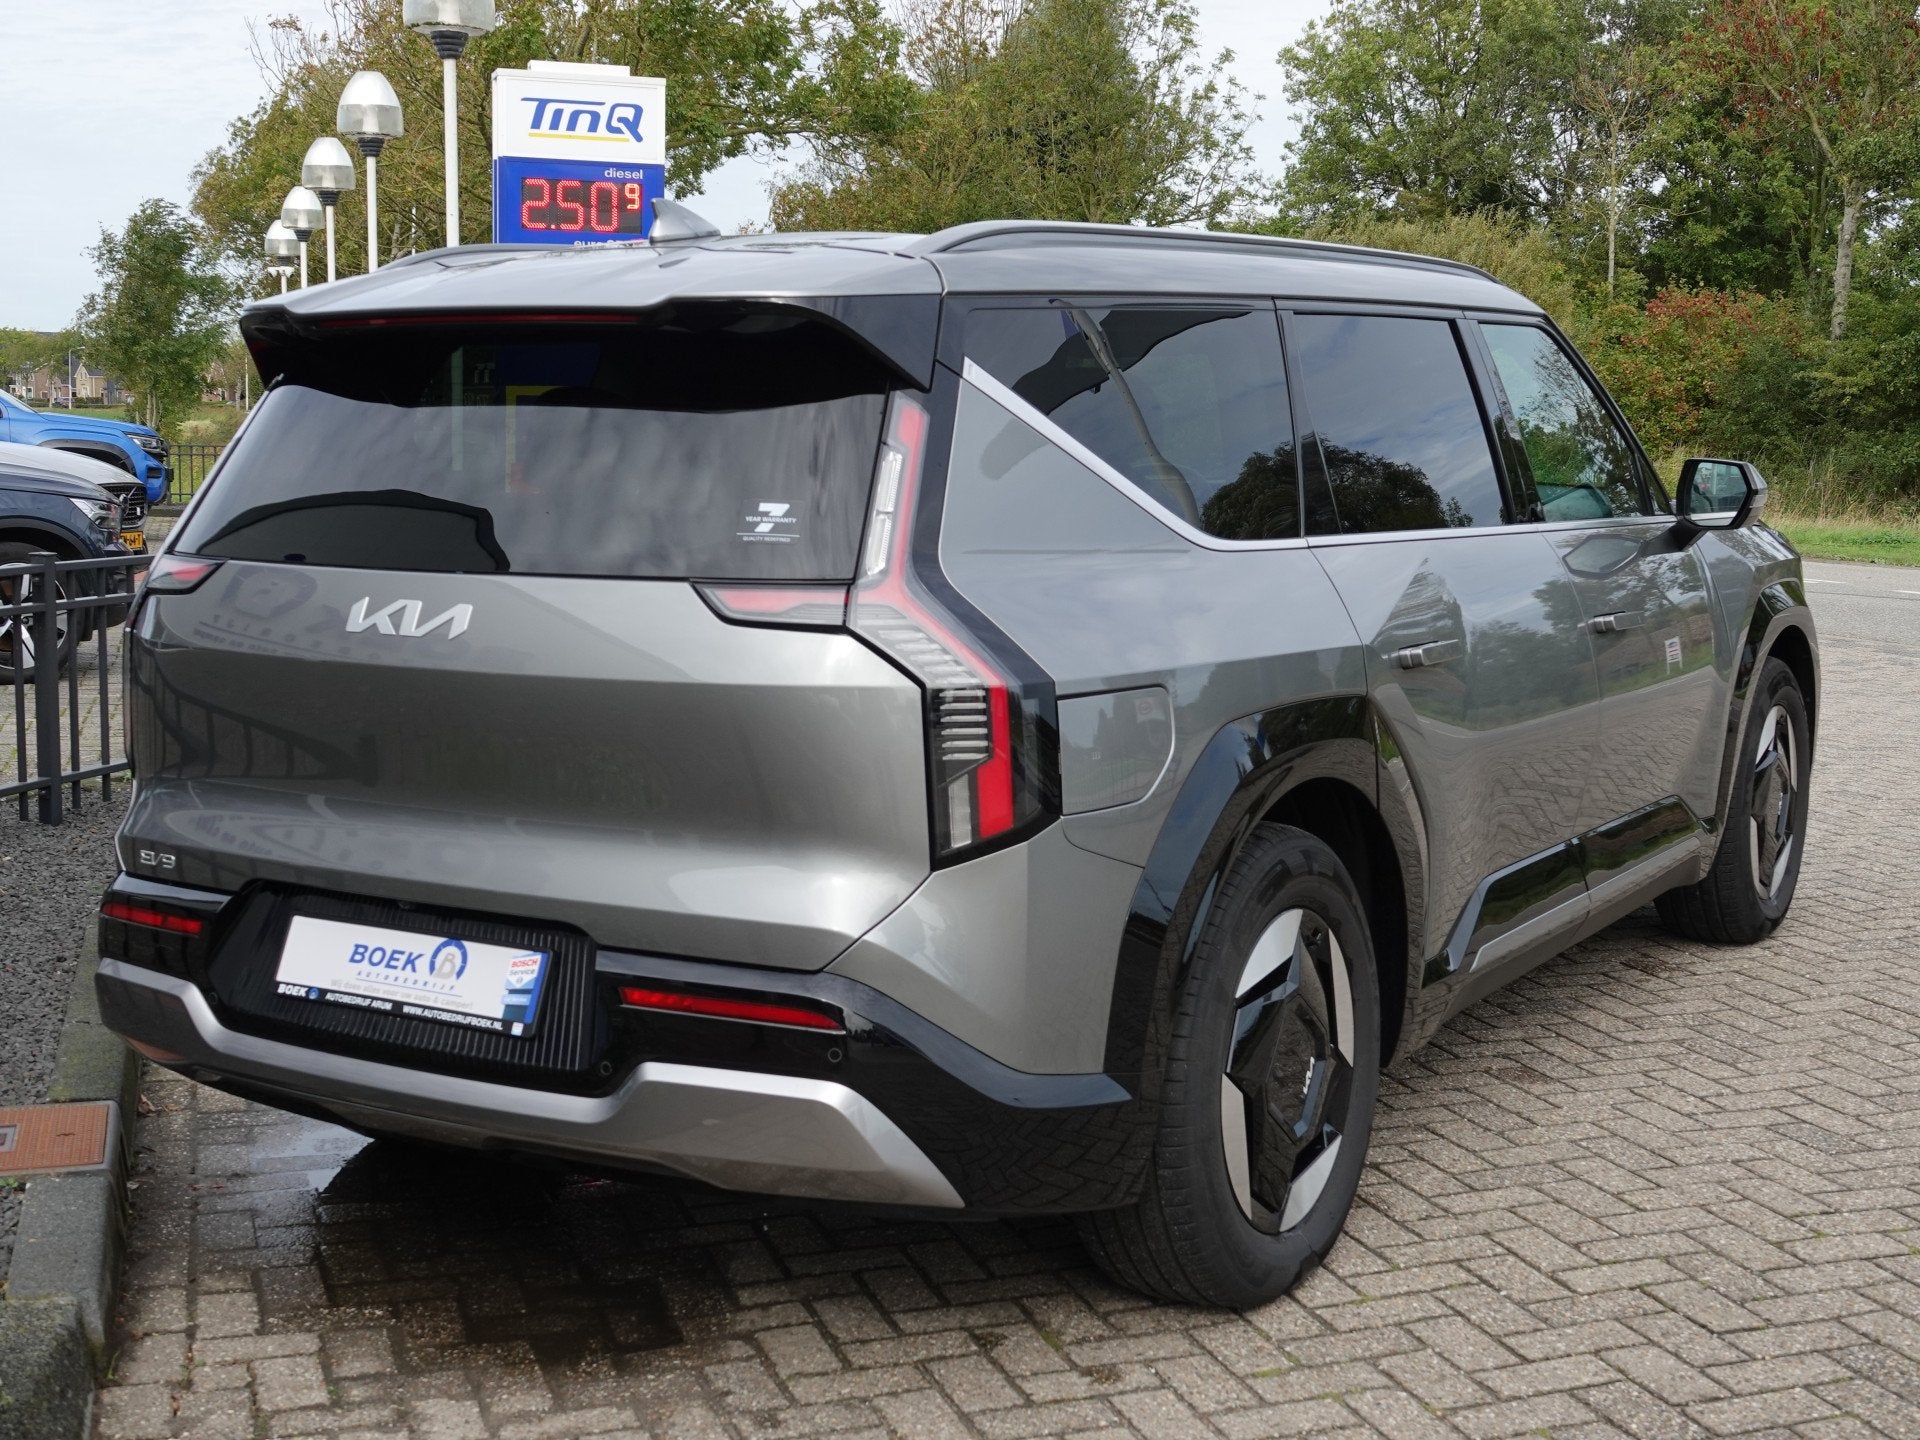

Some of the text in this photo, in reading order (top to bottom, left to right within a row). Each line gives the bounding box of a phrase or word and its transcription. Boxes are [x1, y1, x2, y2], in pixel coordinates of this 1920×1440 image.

[604, 168, 643, 179] diesel
[345, 596, 473, 640] KIA
[349, 944, 424, 973] BOEK
[511, 958, 539, 968] BOSCH
[278, 984, 309, 997] BOEK
[325, 992, 371, 1006] AUTOBEDRIJF
